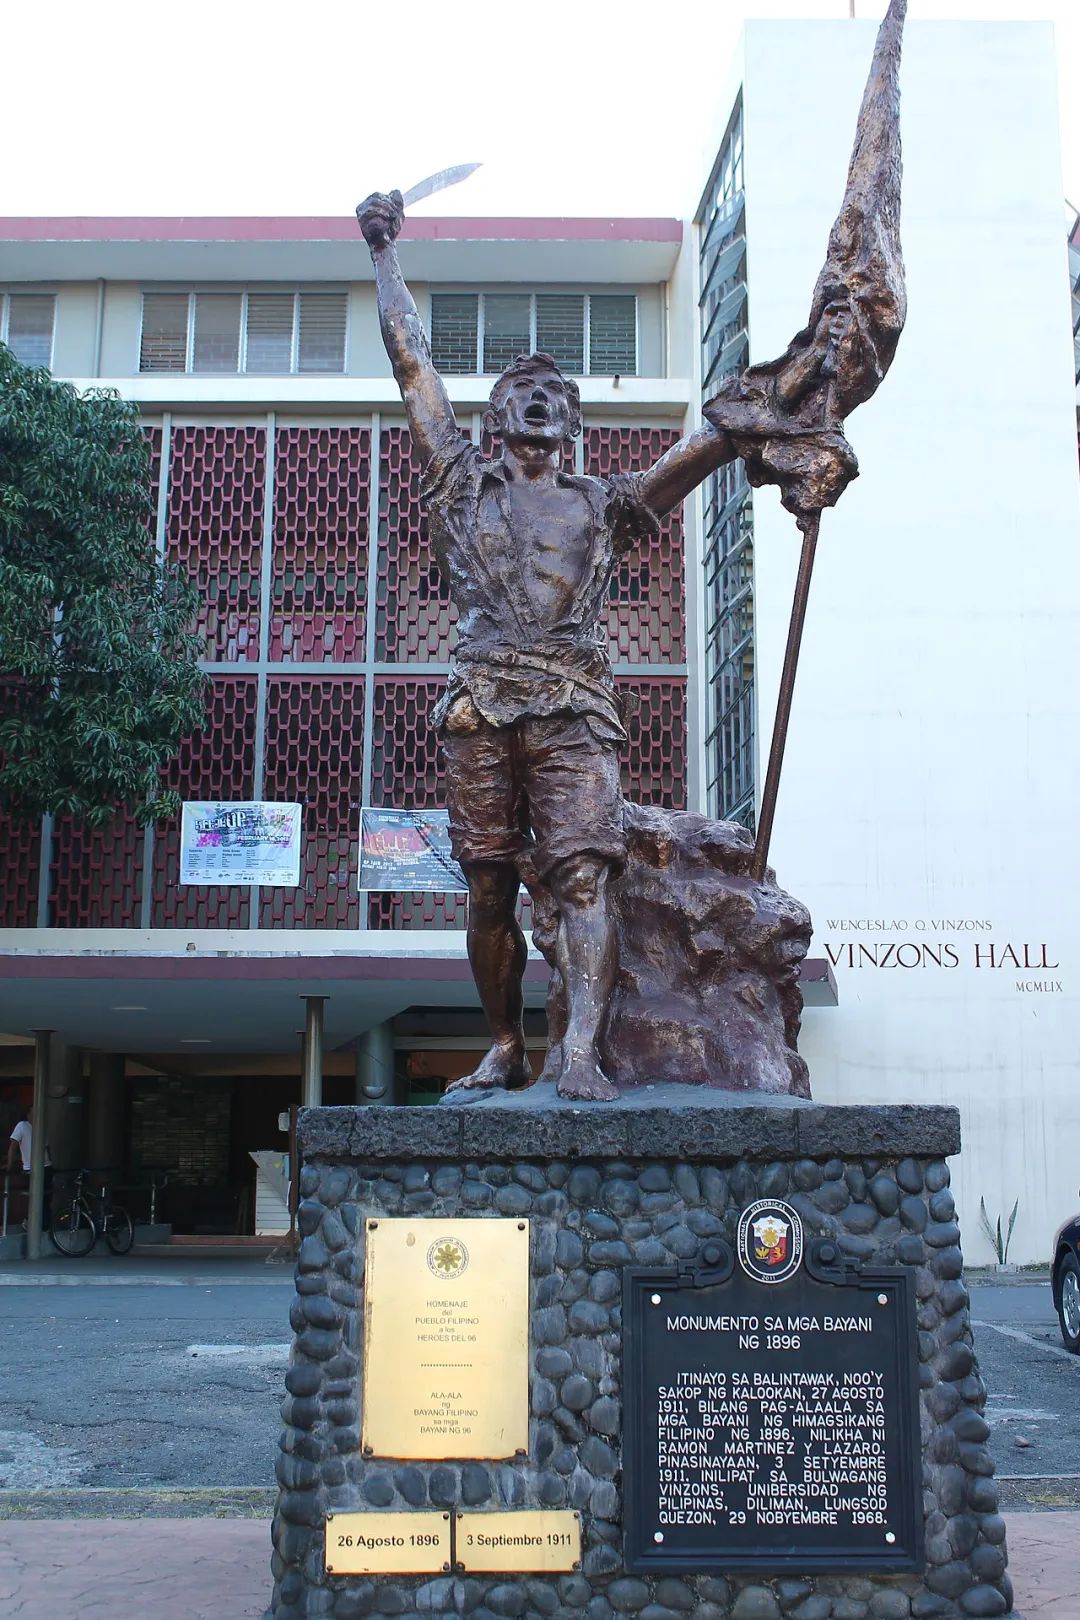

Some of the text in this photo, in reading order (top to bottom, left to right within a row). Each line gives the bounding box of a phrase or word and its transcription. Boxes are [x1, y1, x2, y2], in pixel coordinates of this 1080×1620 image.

[826, 919, 908, 931] WENCESLAO
[932, 919, 993, 931] VINZONS
[824, 943, 1059, 968] VINZONS HALL
[1015, 981, 1063, 992] MCMLIX
[750, 1202, 786, 1213] HISTORICAL
[426, 1300, 469, 1308] HOMENAJE
[415, 1317, 479, 1325] PUEBLO FILIPINO
[667, 1316, 872, 1331] MONUMENTO SA MGA BAYANI
[417, 1334, 450, 1342] HEROES
[451, 1334, 466, 1342] DEL
[739, 1335, 801, 1349] NG 1896
[677, 1371, 884, 1387] ITINAYO SA BALINTAWAK, NOO'Y
[430, 1392, 462, 1400] ALA-ALA
[658, 1387, 884, 1401] SAKOP NG KALOOKAN, 27 AGOSTO
[413, 1409, 479, 1417] BAYANG FILIPINO
[658, 1401, 885, 1414] 1911, BILANG PAG-ALAALA SA
[443, 1419, 458, 1427] mga
[658, 1414, 885, 1428] MGA BAYANI NG HIMAGSIKANG
[420, 1426, 448, 1434] BAYANI
[449, 1426, 460, 1434] NG
[658, 1428, 886, 1441] FILIPINO NG 1896. NILIKHA NI
[658, 1442, 886, 1455] RAMON MARTINEZ Y LAZARO.
[658, 1455, 886, 1470] PINASINAYAAN, 3 SETYEMBRE
[658, 1469, 887, 1483] 1911. INILIPAT SA BULWAGANG
[659, 1483, 887, 1497] VINZONS, UNIBERSIDAD NG
[658, 1497, 888, 1511] PILIPINAS, DILIMAN, LUNGSOD
[658, 1511, 888, 1525] QUEZON, 29 NOBYEMBRE 1968.
[337, 1535, 440, 1549] 26 Agosto 1896
[467, 1533, 572, 1548] 3 Septiembre 1911
